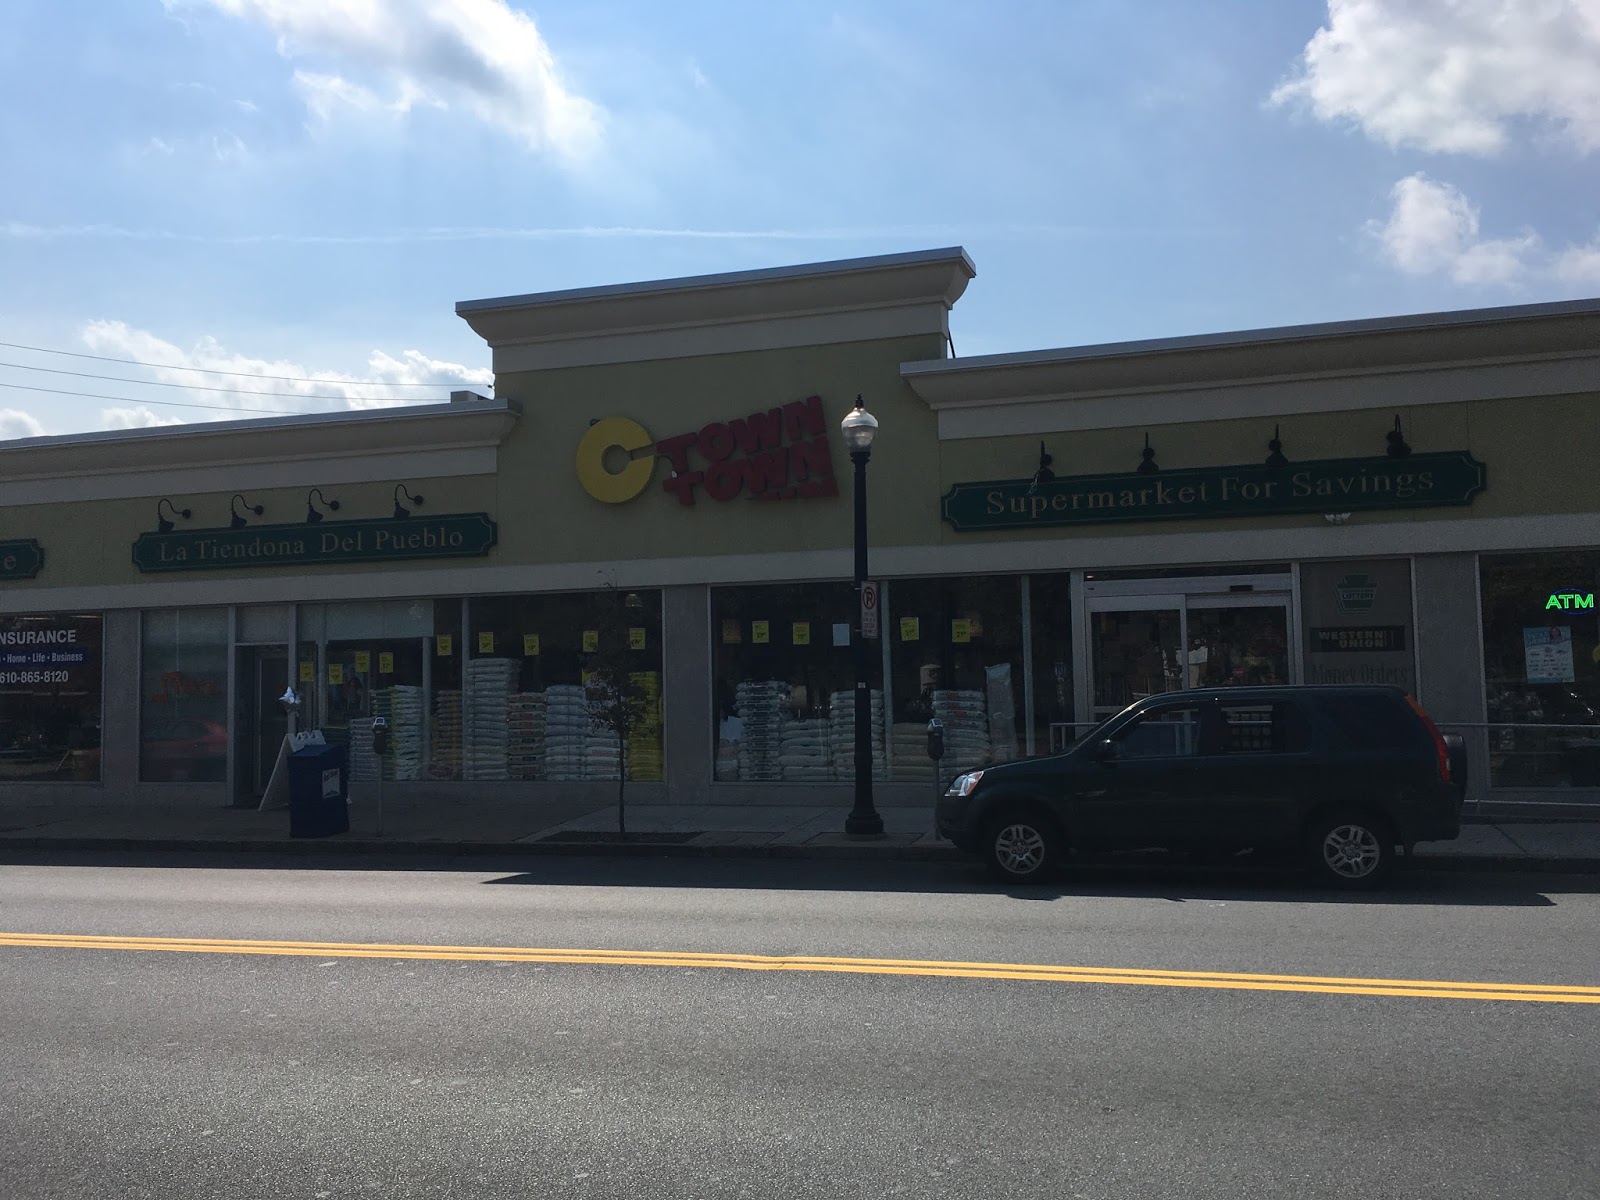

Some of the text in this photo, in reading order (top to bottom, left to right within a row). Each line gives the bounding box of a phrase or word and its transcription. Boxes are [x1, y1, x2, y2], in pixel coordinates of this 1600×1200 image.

[656, 395, 826, 474] TOWN
[663, 435, 835, 505] TOWN
[987, 466, 1434, 518] Supermarket For Savings
[160, 528, 463, 561] La Tiendona Del Pueblo
[1342, 592, 1375, 600] LOTTERY
[1545, 593, 1595, 610] ATM
[0, 630, 76, 645] NSURANCE
[1319, 630, 1384, 641] WESTERN
[1339, 639, 1385, 649] UNION
[6, 652, 83, 663] Home Life Business
[0, 671, 69, 684] 610-865-8120
